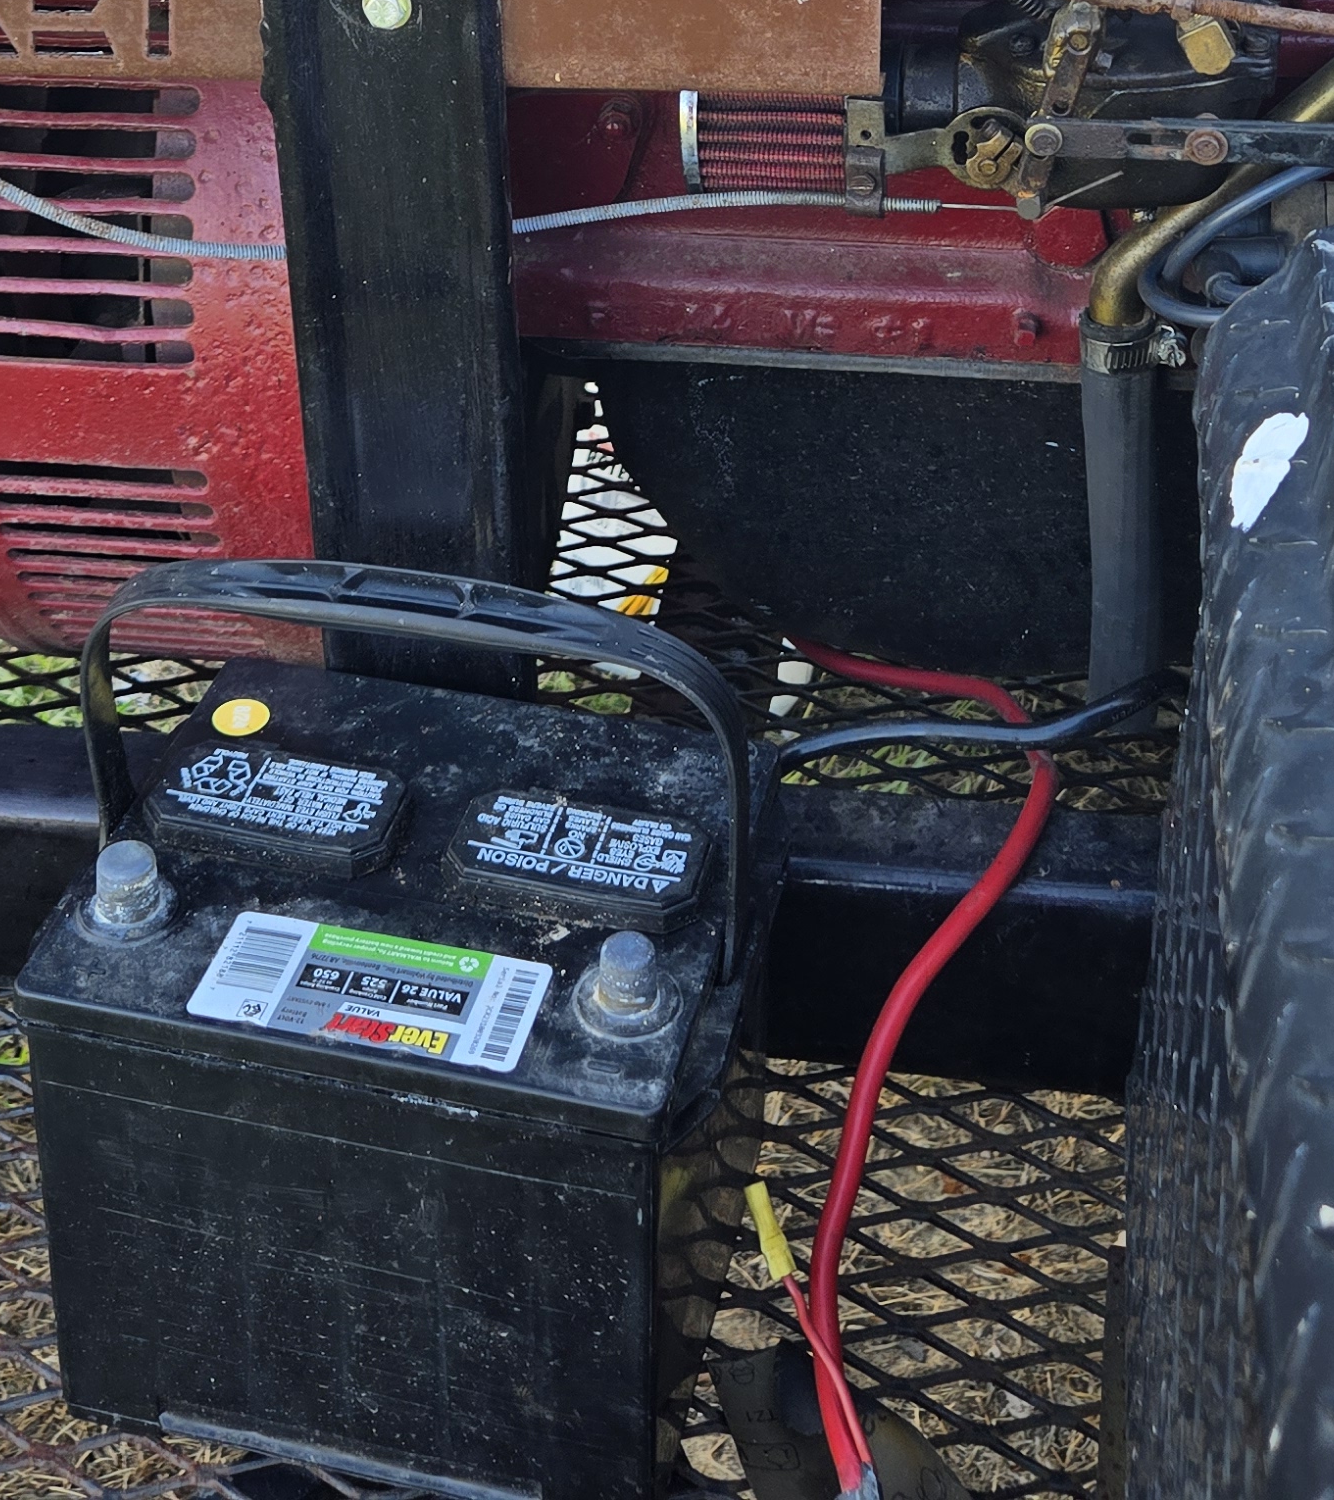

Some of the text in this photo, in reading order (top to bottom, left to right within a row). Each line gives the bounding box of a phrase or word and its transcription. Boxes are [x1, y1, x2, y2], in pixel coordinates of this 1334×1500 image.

[293, 789, 314, 800] HELP
[315, 793, 348, 806] MEDICAL
[188, 802, 228, 816] CHILDREN
[246, 796, 294, 811] IMMEDIATELY
[322, 802, 343, 813] WITH
[295, 805, 315, 815] EYES
[314, 808, 340, 820] FLUSH
[285, 819, 297, 829] OF
[287, 814, 307, 825] KEEP
[324, 820, 342, 831] NOT
[476, 812, 548, 833] SULFURIC ACID
[298, 822, 315, 832] OUT
[315, 825, 337, 836] KEEP
[568, 829, 586, 840] NO
[632, 833, 663, 846] GASES
[608, 838, 661, 855] EXPLOSIVE
[609, 847, 635, 858] EYES
[475, 847, 551, 872] POISON
[595, 851, 633, 867] SHIELD
[566, 864, 649, 890] DANGER
[322, 937, 353, 949] recycling
[353, 942, 376, 952] proper
[386, 949, 421, 961] WALMART
[422, 949, 443, 958] credit
[443, 953, 457, 961] and
[330, 956, 340, 964] AR
[313, 967, 340, 980] 650
[395, 967, 426, 979] Walmart
[425, 971, 432, 980] by
[360, 975, 388, 989] 525
[431, 974, 474, 988] Distributed
[401, 983, 462, 1003] VALUE 26
[344, 1004, 382, 1017] VALUE
